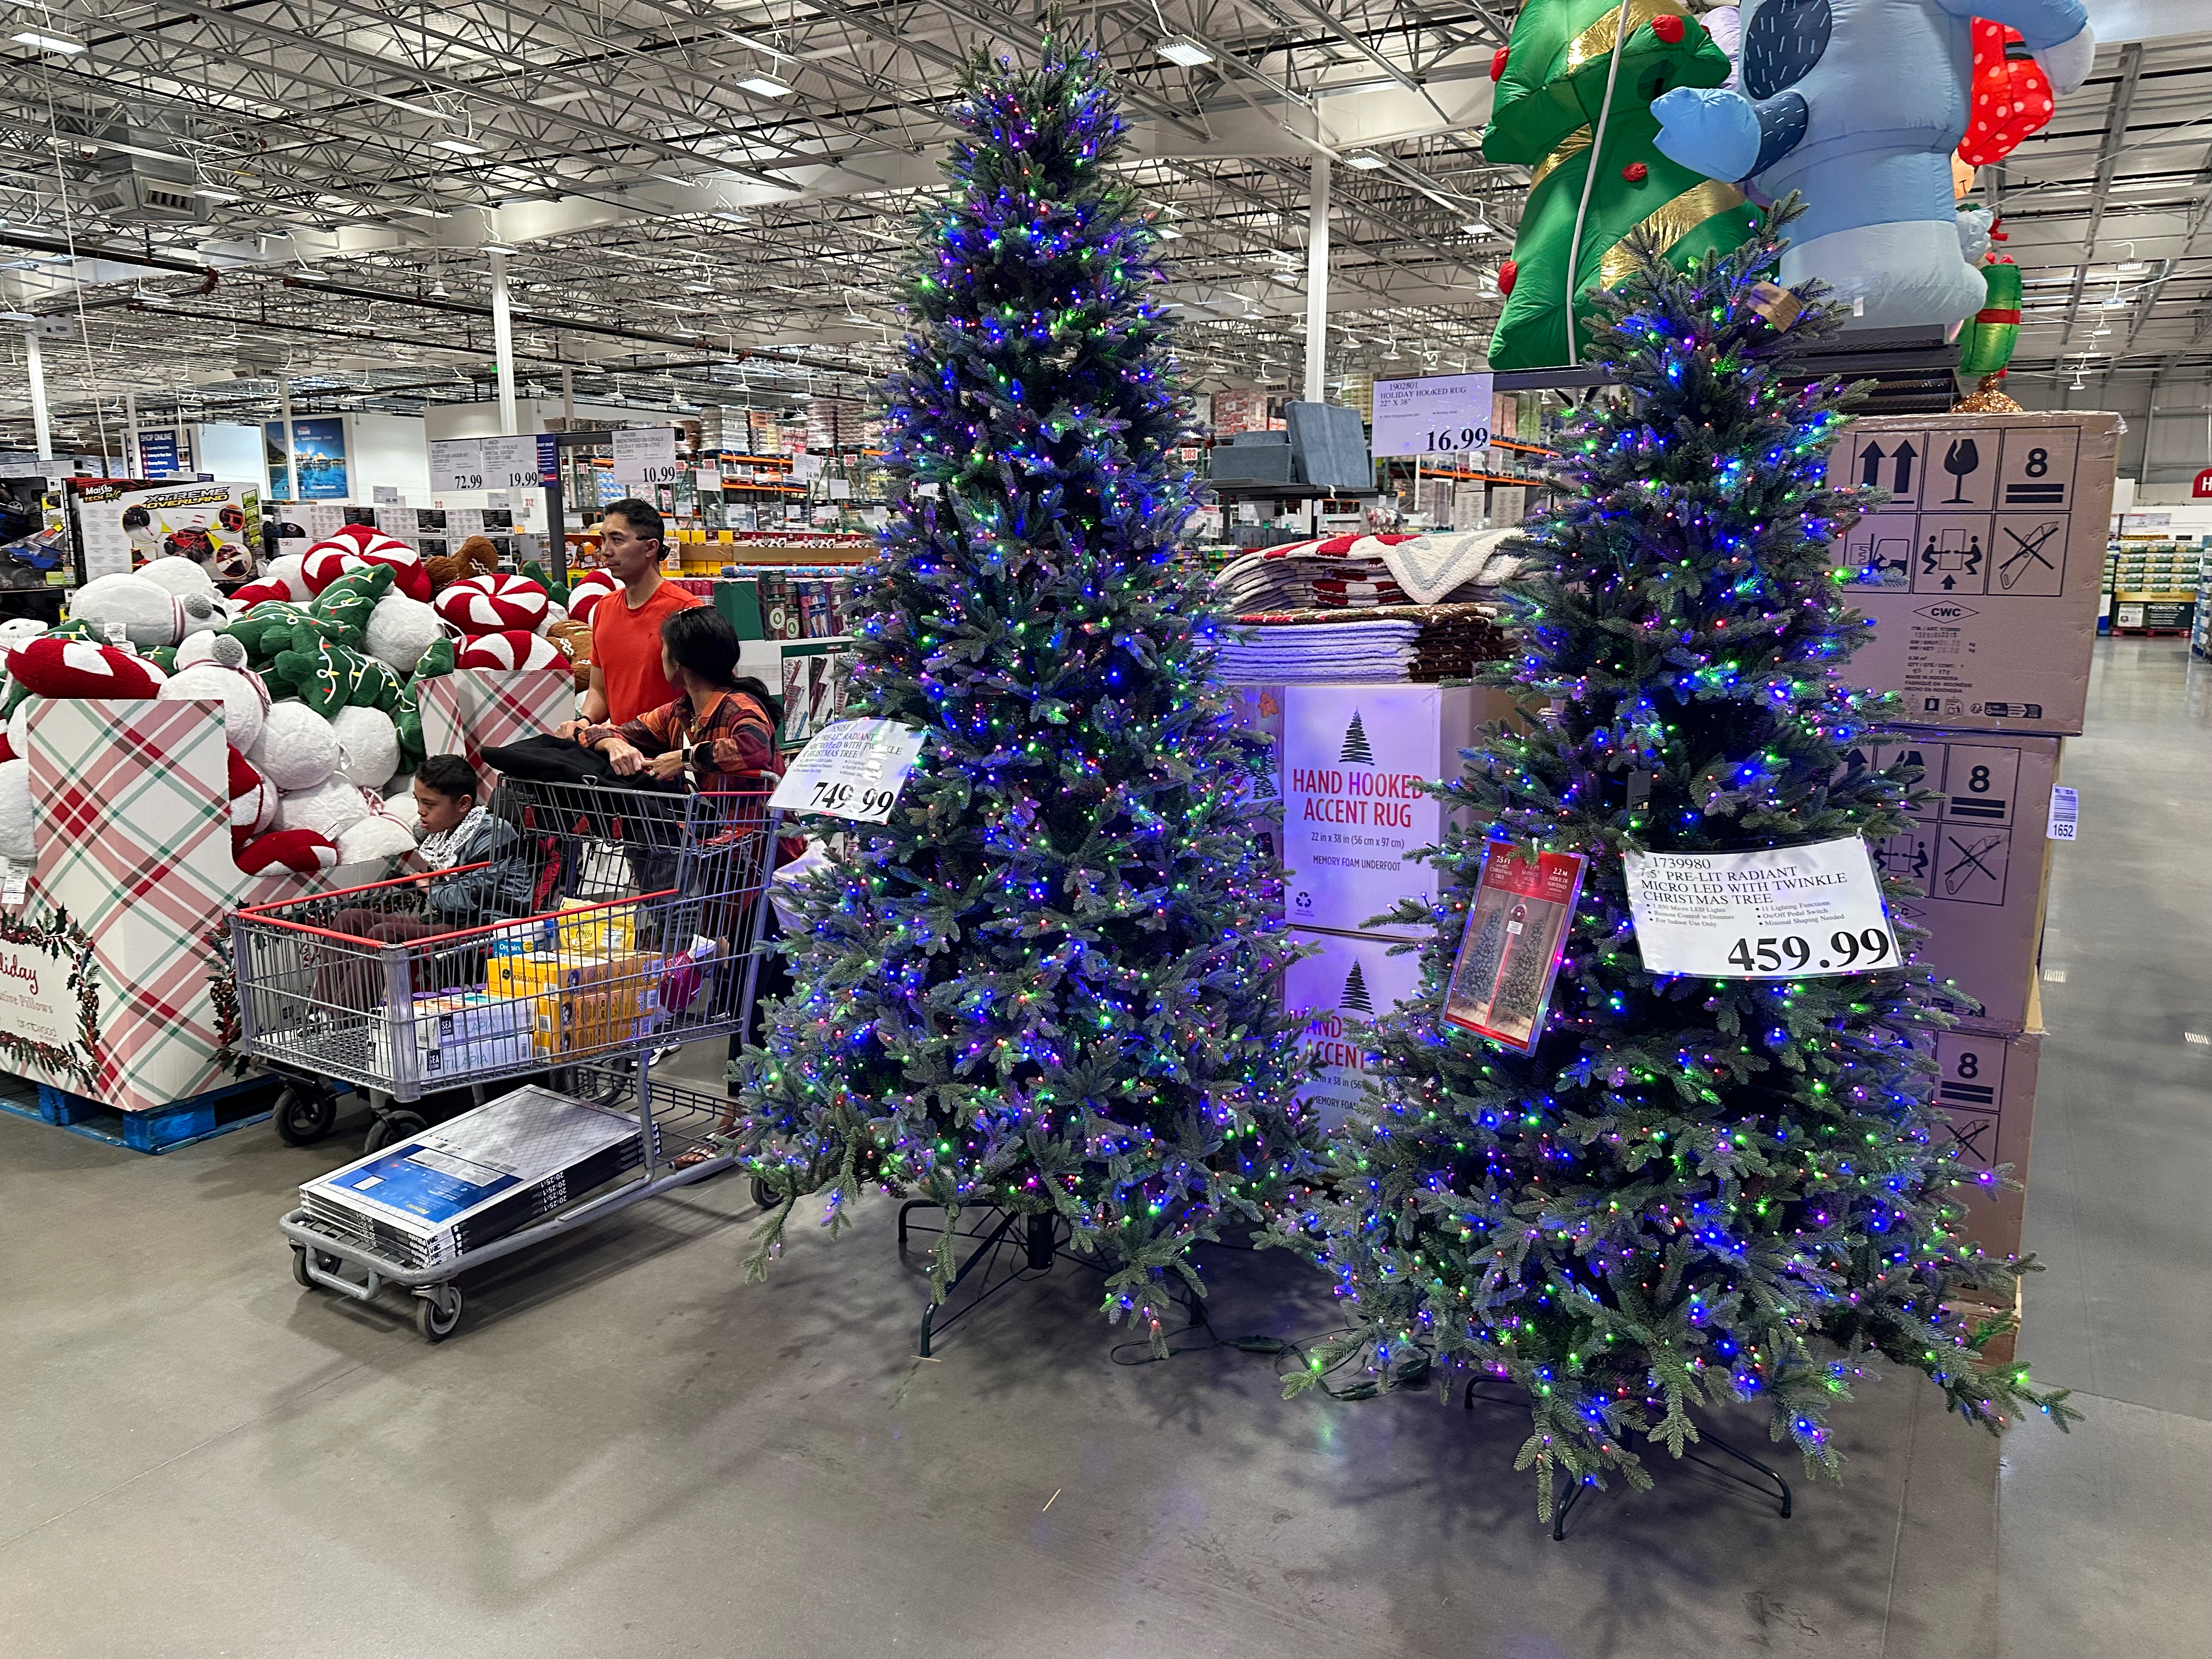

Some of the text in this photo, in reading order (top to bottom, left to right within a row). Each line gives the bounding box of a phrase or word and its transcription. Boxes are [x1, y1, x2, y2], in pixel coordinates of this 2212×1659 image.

[1380, 391, 1414, 399] HOLIDAY
[1416, 388, 1447, 396] HOOKED
[1390, 382, 1418, 391] 1902801
[1426, 428, 1488, 451] 16.99
[2025, 448, 2047, 478] 8
[454, 474, 482, 489] 72.99
[509, 472, 537, 487] 19.99
[643, 466, 675, 482] 10.99
[86, 484, 112, 495] Maisto
[146, 494, 228, 509] OVERLAND
[525, 498, 534, 506] 312
[1931, 608, 1961, 617] CWC
[843, 733, 876, 741] RADIANT
[1293, 769, 1424, 799] HAND HOOKED
[1968, 764, 1990, 793] 8
[810, 782, 894, 816] 74999
[1304, 797, 1411, 828] ACCENT RUG
[2053, 823, 2074, 837] 1652
[1311, 832, 1319, 841] 22
[1320, 833, 1327, 842] in
[1334, 834, 1341, 843] 38
[1343, 834, 1350, 844] in
[1351, 835, 1362, 845] (56
[1381, 837, 1389, 847] 97
[1391, 839, 1404, 849] cm)
[1313, 855, 1401, 871] MEMORY FOAM UNDERFOOT
[1652, 857, 1711, 869] 1739980
[1489, 867, 1513, 876] CHRISTMAS
[1666, 871, 1722, 882] PRE-LIT
[1728, 866, 1797, 881] RADIANT
[1547, 881, 1567, 889] NAVIDAD
[1641, 872, 1848, 893] MICRO LED WITH TWINKLE
[1643, 891, 1773, 905] CHRISTMAS TREE
[1771, 904, 1797, 912] Lighting
[1799, 900, 1830, 909] Functions
[1793, 917, 1819, 926] Shaping
[1727, 928, 1889, 972] 459.99
[19, 995, 53, 1013] Pillows
[442, 1020, 452, 1030] SEA
[1294, 1010, 1342, 1038] AND
[430, 1056, 439, 1064] SEA
[1957, 1052, 1978, 1079] 8
[1333, 1076, 1341, 1085] 38
[1342, 1077, 1348, 1087] in
[541, 1171, 564, 1188] 20x25x1
[543, 1180, 566, 1196] 20x25x1
[543, 1187, 567, 1204] 20x25x1
[544, 1195, 567, 1212] 20x25x1
[427, 1235, 438, 1245] 3M
[430, 1243, 441, 1254] 3M
